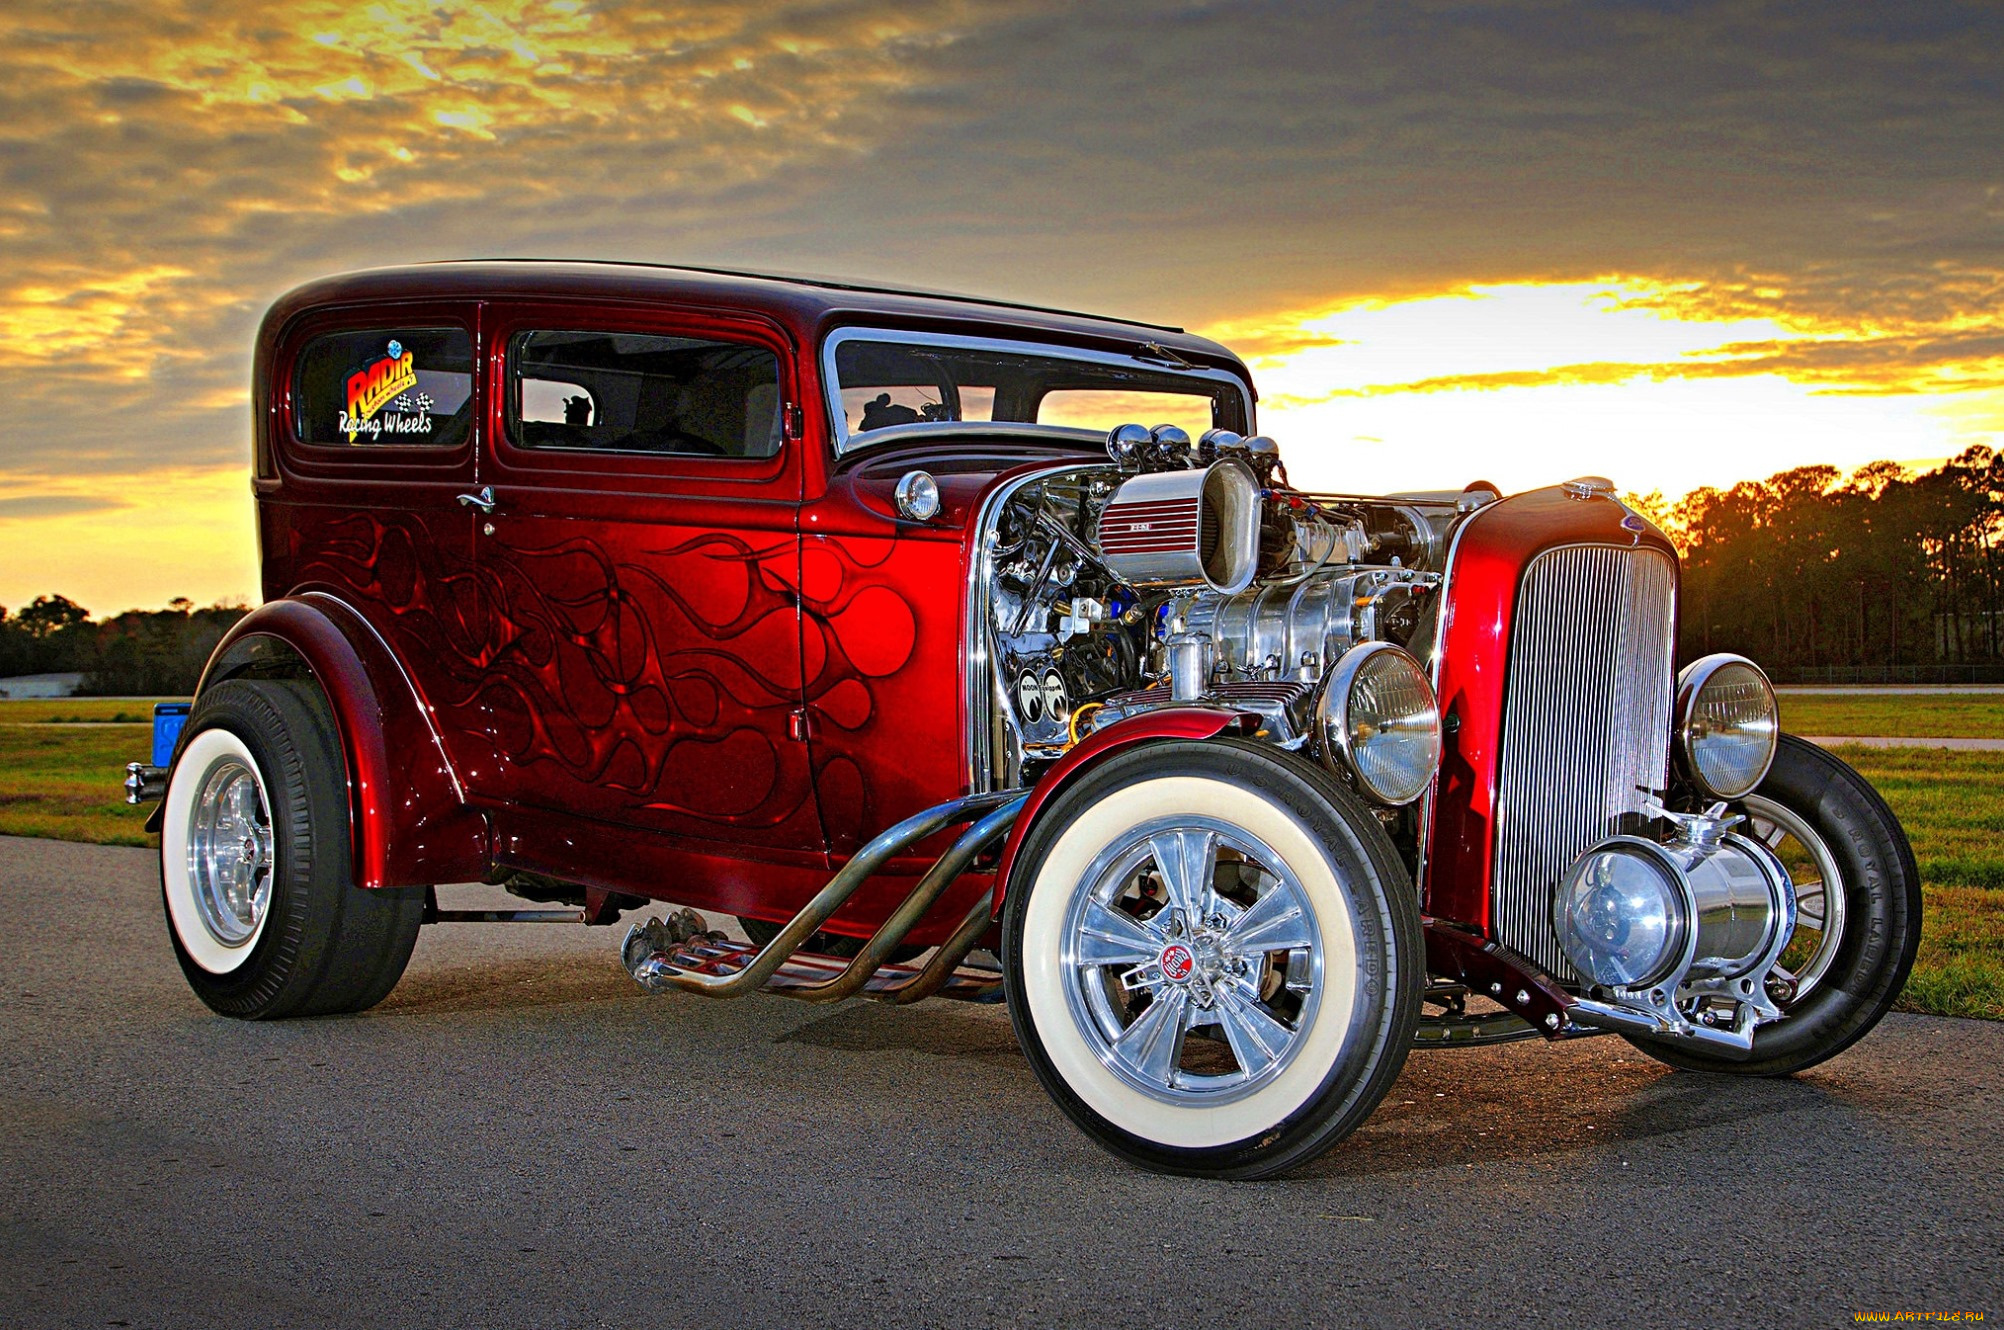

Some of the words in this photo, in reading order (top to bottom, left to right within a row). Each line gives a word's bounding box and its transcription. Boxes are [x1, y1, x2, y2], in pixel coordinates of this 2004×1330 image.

[339, 410, 382, 440] Racing
[384, 411, 432, 433] Wheels
[347, 351, 413, 432] RADIR
[1848, 828, 1883, 904] ROYAL
